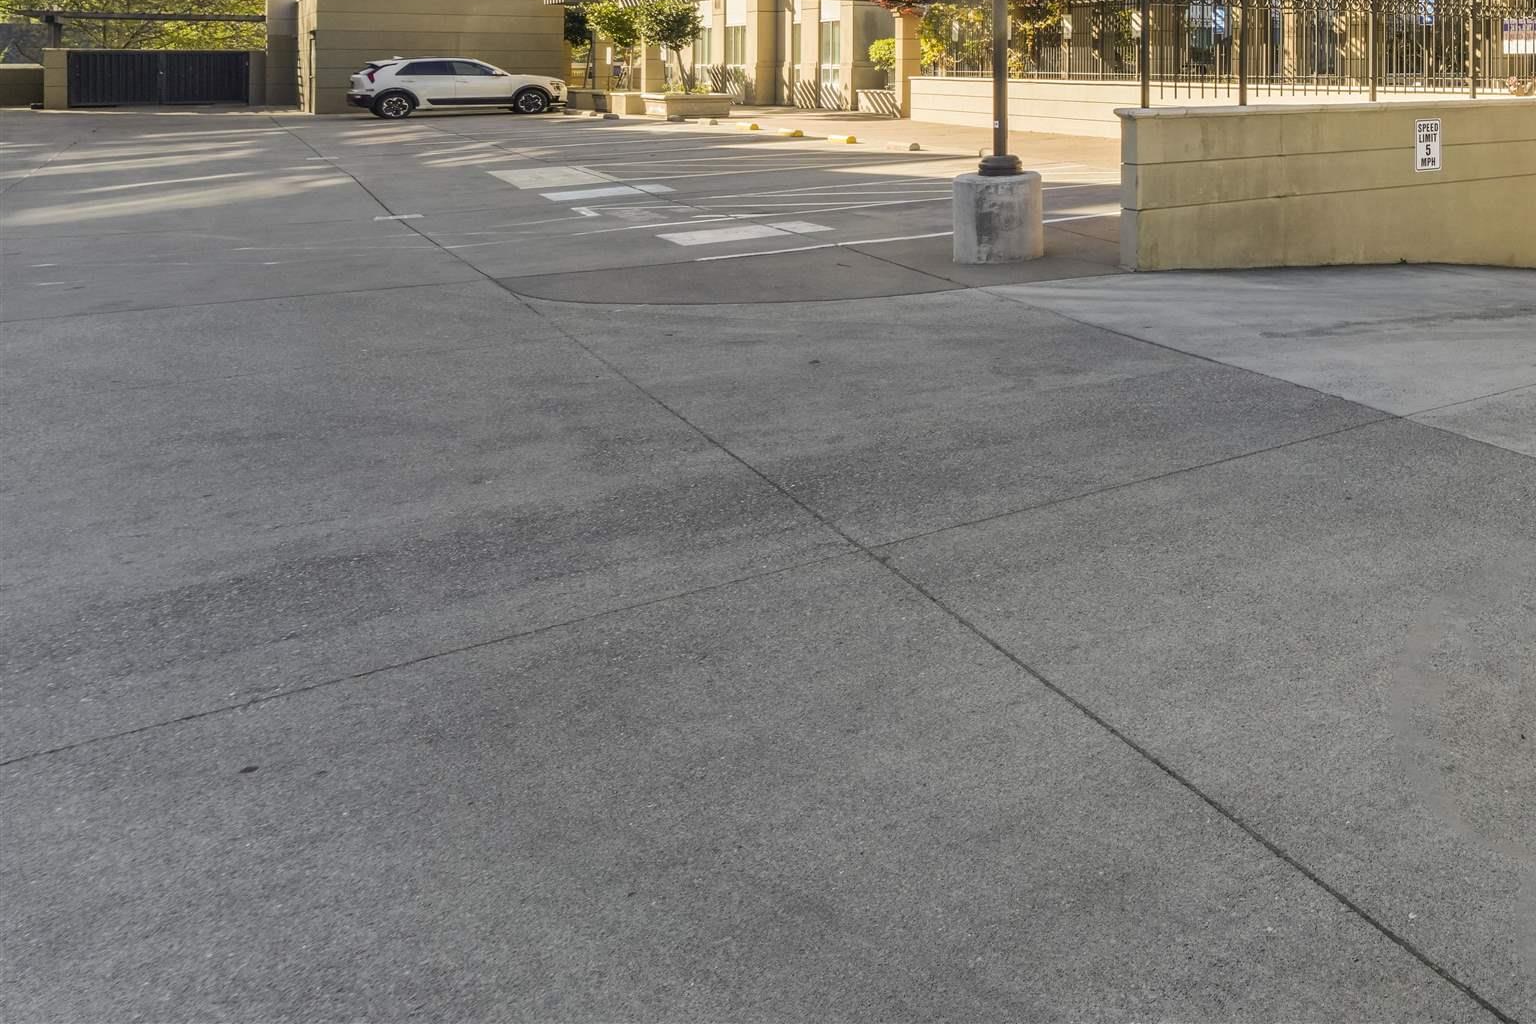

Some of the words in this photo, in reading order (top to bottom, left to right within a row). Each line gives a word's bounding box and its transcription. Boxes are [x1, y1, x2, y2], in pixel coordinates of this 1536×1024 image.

[1418, 123, 1438, 132] SPEED
[1419, 133, 1437, 143] LIMIT
[1425, 144, 1431, 156] 5
[1421, 157, 1436, 167] MPH
